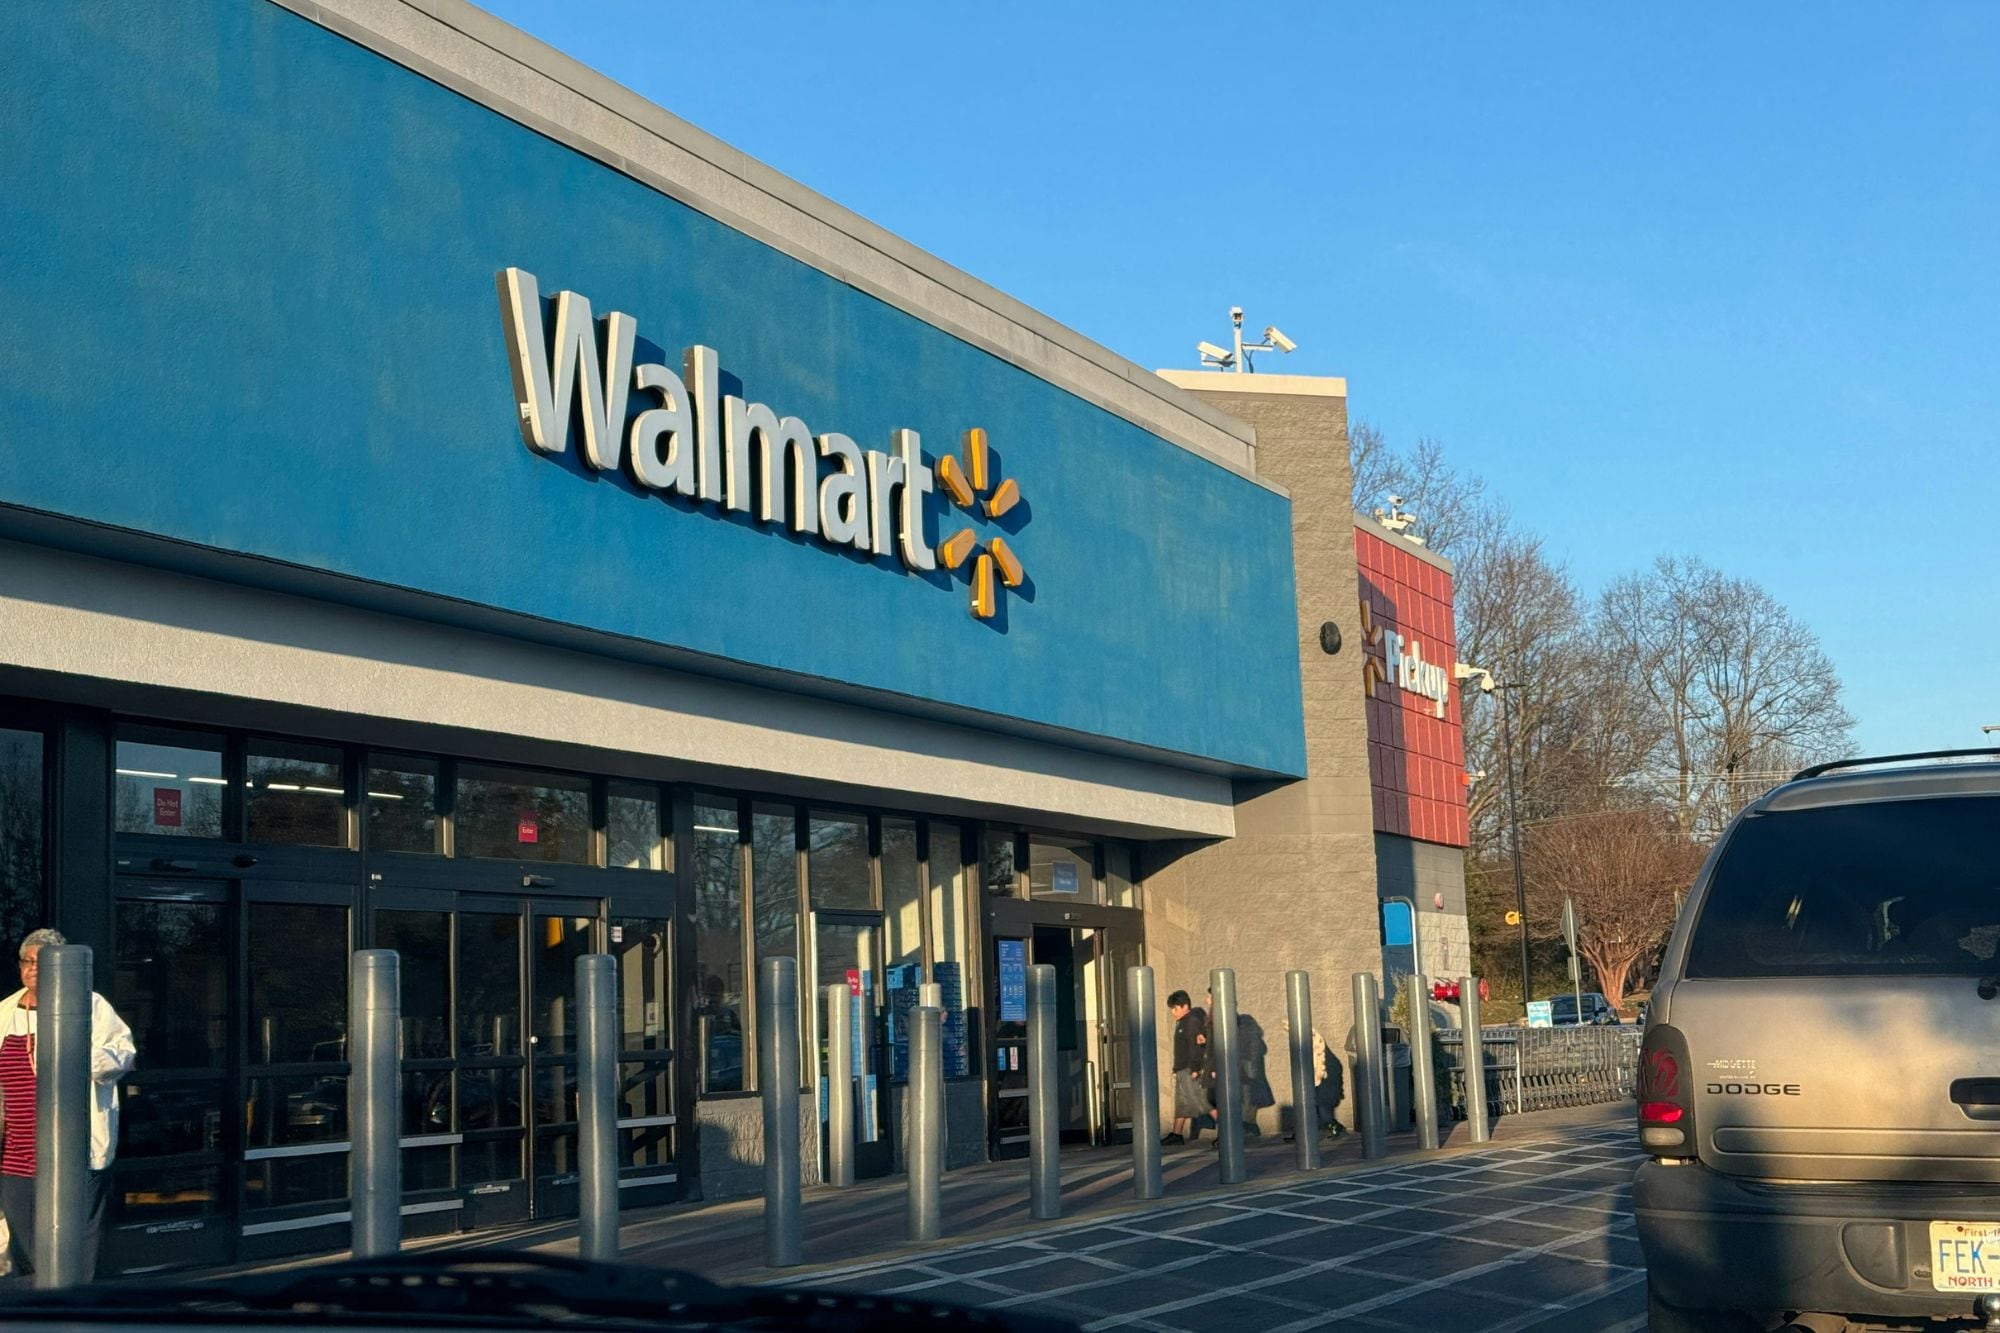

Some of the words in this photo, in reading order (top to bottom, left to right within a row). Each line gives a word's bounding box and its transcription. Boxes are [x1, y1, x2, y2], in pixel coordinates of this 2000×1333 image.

[498, 266, 936, 571] Walmart
[1384, 629, 1448, 718] Pickup
[1706, 1083, 1801, 1096] DODGE
[1964, 1228, 1987, 1237] First
[1948, 1276, 1993, 1288] NORTH
